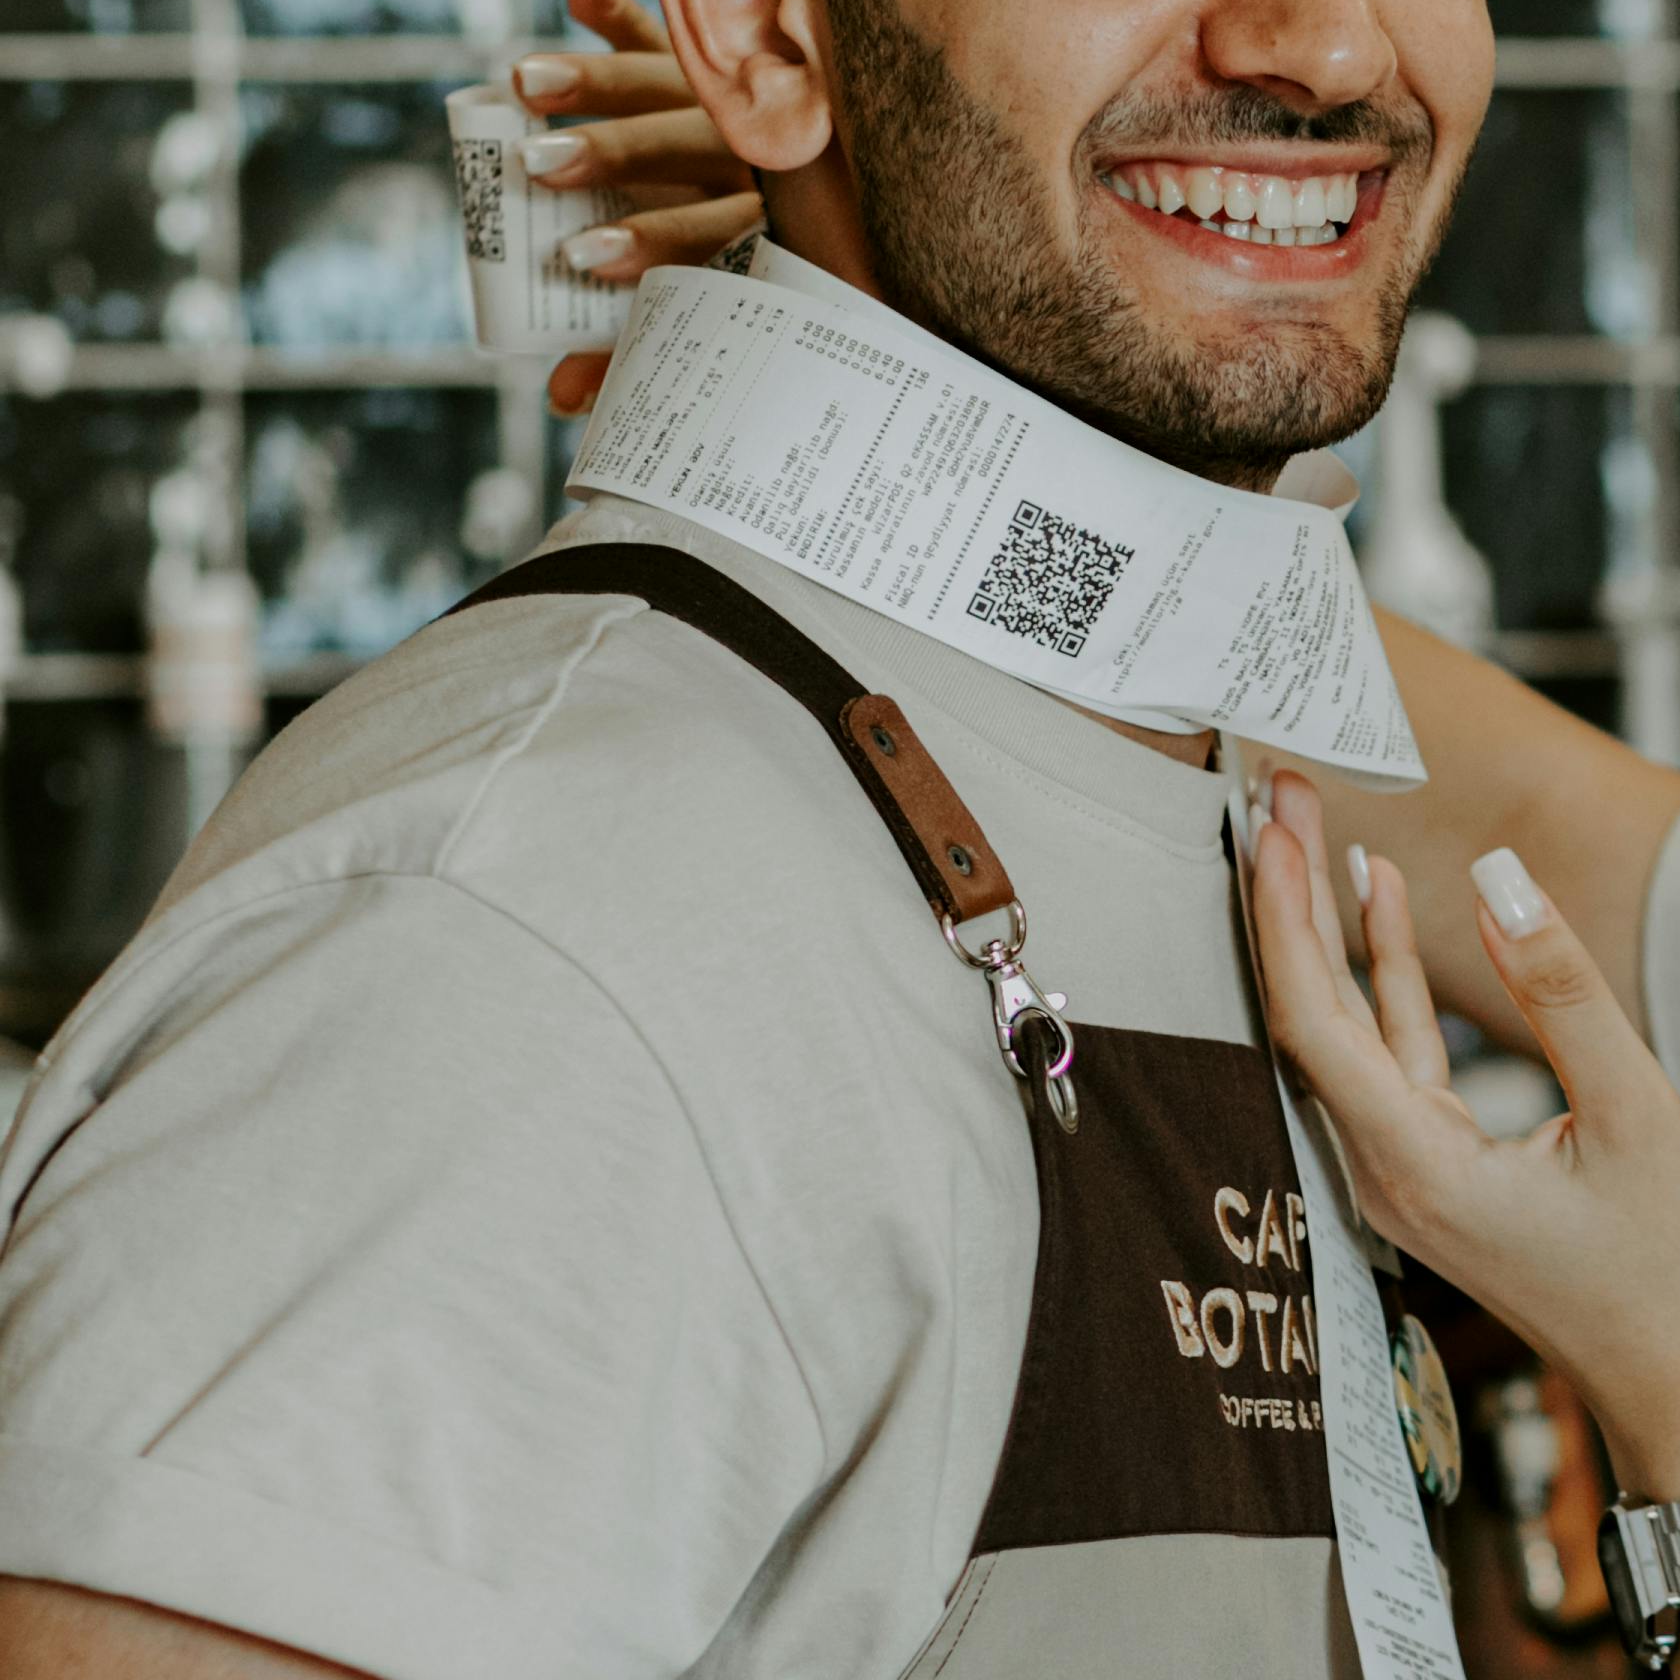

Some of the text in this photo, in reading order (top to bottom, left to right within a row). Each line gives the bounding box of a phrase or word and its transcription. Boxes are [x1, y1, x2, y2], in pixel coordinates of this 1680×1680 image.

[793, 318, 814, 346] 6.40
[804, 322, 825, 350] 0.00
[815, 326, 836, 355] 0.00
[826, 331, 848, 360] 0.00
[838, 337, 859, 365] 0.00
[850, 342, 871, 370] 0.00
[885, 358, 906, 386] 0.00
[667, 465, 692, 499] YEKUN
[763, 306, 785, 334] 0.13
[775, 519, 792, 541] Pul
[861, 347, 882, 376] 0.00
[783, 352, 894, 554] Yekun: 6.40
[821, 519, 856, 574] Vurulmuş
[849, 494, 867, 517] çek
[913, 369, 931, 391] 136
[871, 481, 905, 536] WizarPOS
[934, 381, 955, 411] v.01
[859, 556, 883, 591] Kassa
[911, 449, 936, 485] zavod
[862, 475, 891, 522] modeli:
[883, 562, 910, 603] Fiscal
[905, 543, 920, 559] ID
[1214, 1186, 1306, 1272] CAF
[1160, 1280, 1319, 1376] BOTA
